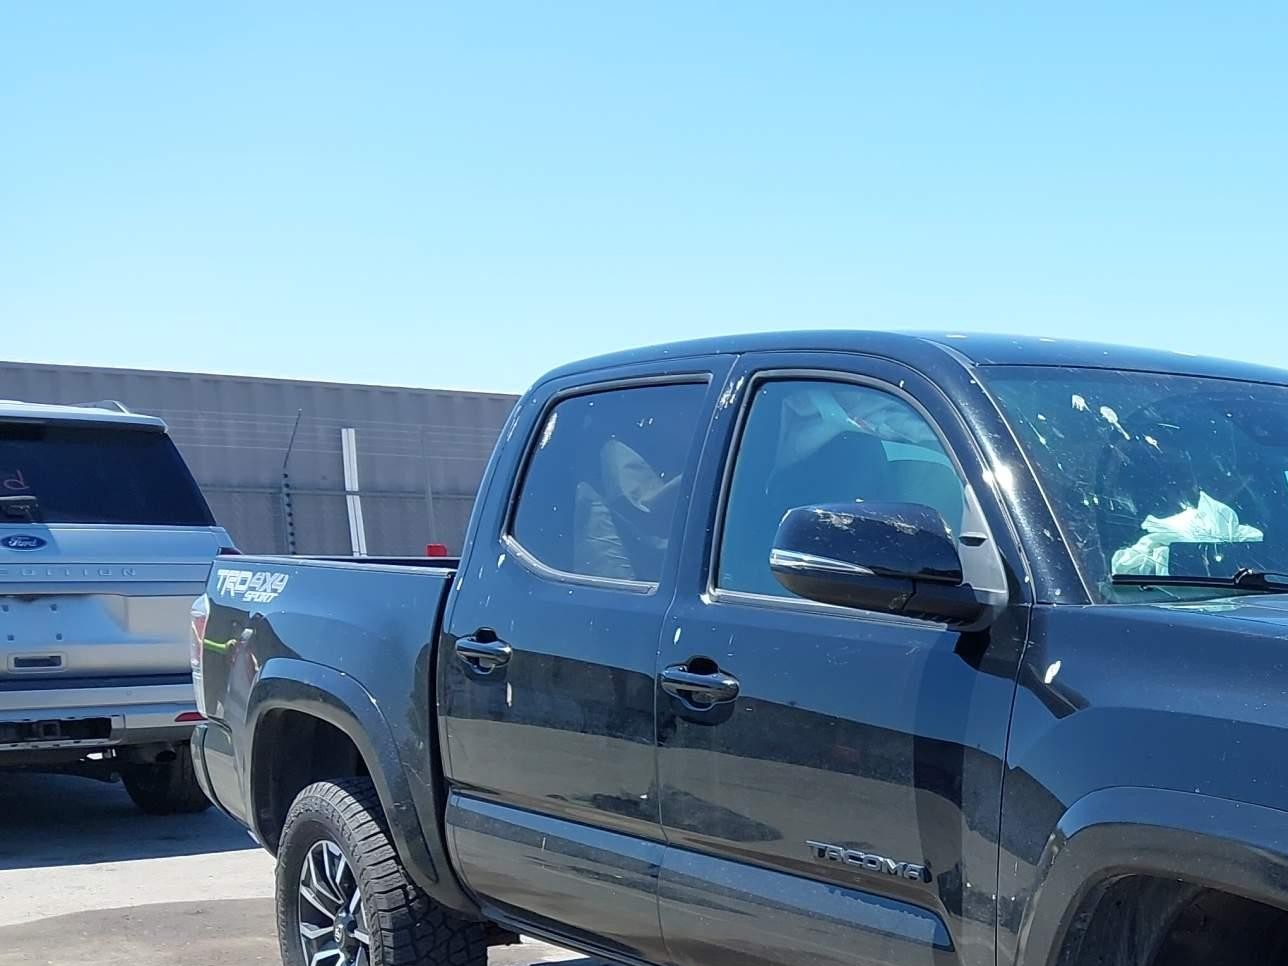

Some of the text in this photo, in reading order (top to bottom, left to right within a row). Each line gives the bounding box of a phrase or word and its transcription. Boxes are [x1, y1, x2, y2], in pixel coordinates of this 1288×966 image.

[8, 537, 37, 547] Ford
[241, 591, 279, 603] SPORT
[806, 840, 932, 883] TACOMA
